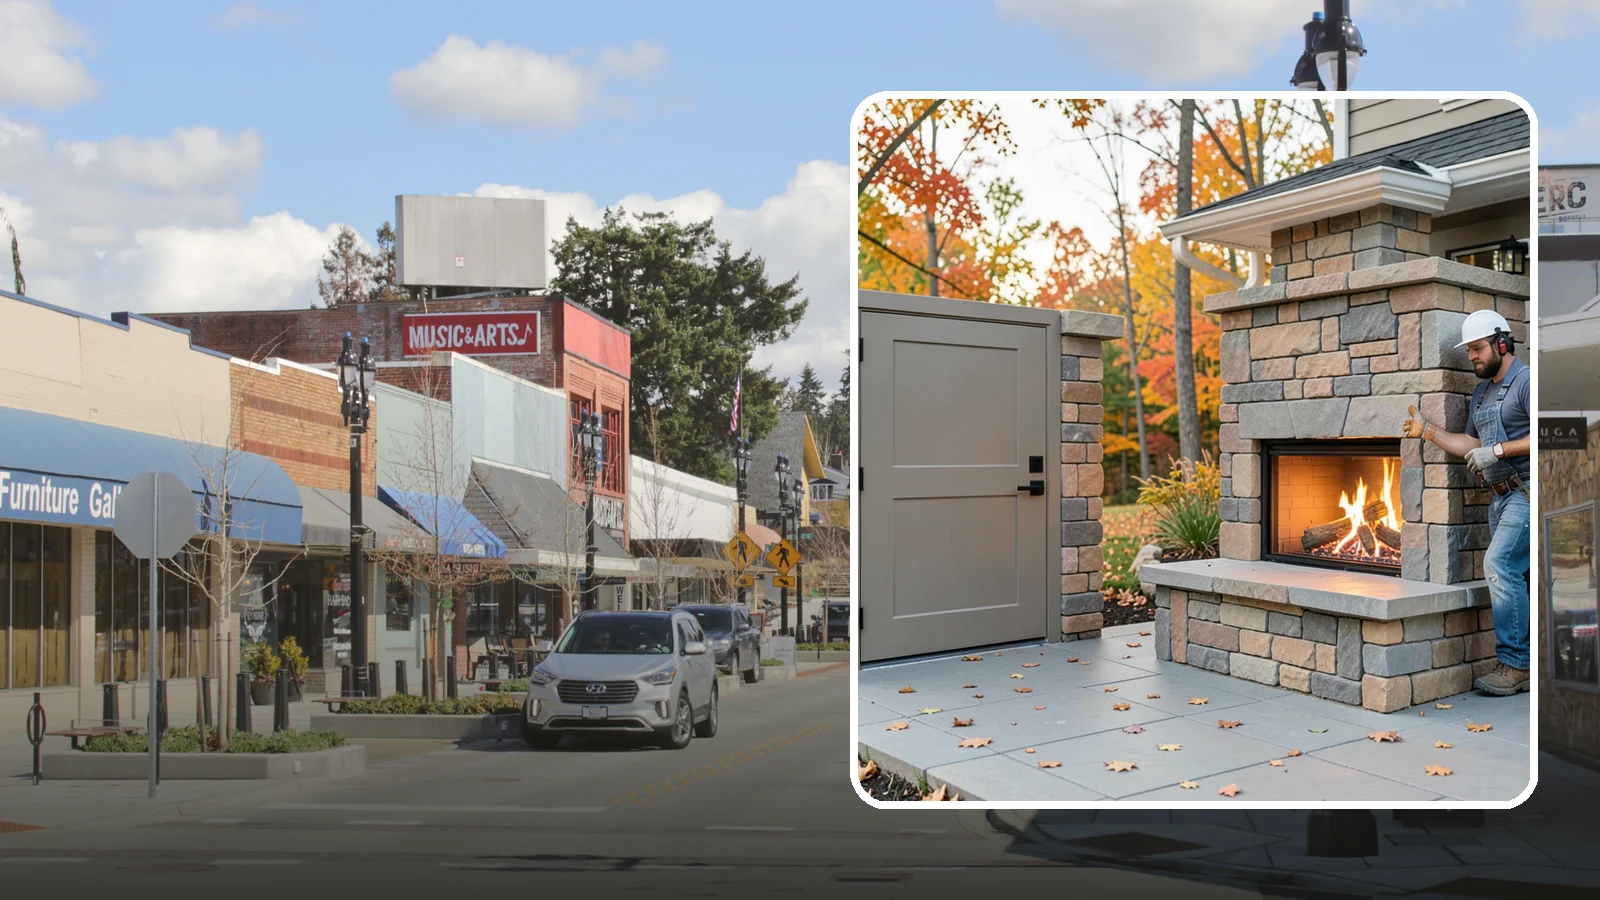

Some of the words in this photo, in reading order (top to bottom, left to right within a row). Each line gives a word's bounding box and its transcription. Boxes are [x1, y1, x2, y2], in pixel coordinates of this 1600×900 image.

[408, 322, 520, 348] MUSIC&ARTS
[0, 471, 79, 516] Furniture
[453, 563, 479, 575] SUSHI
